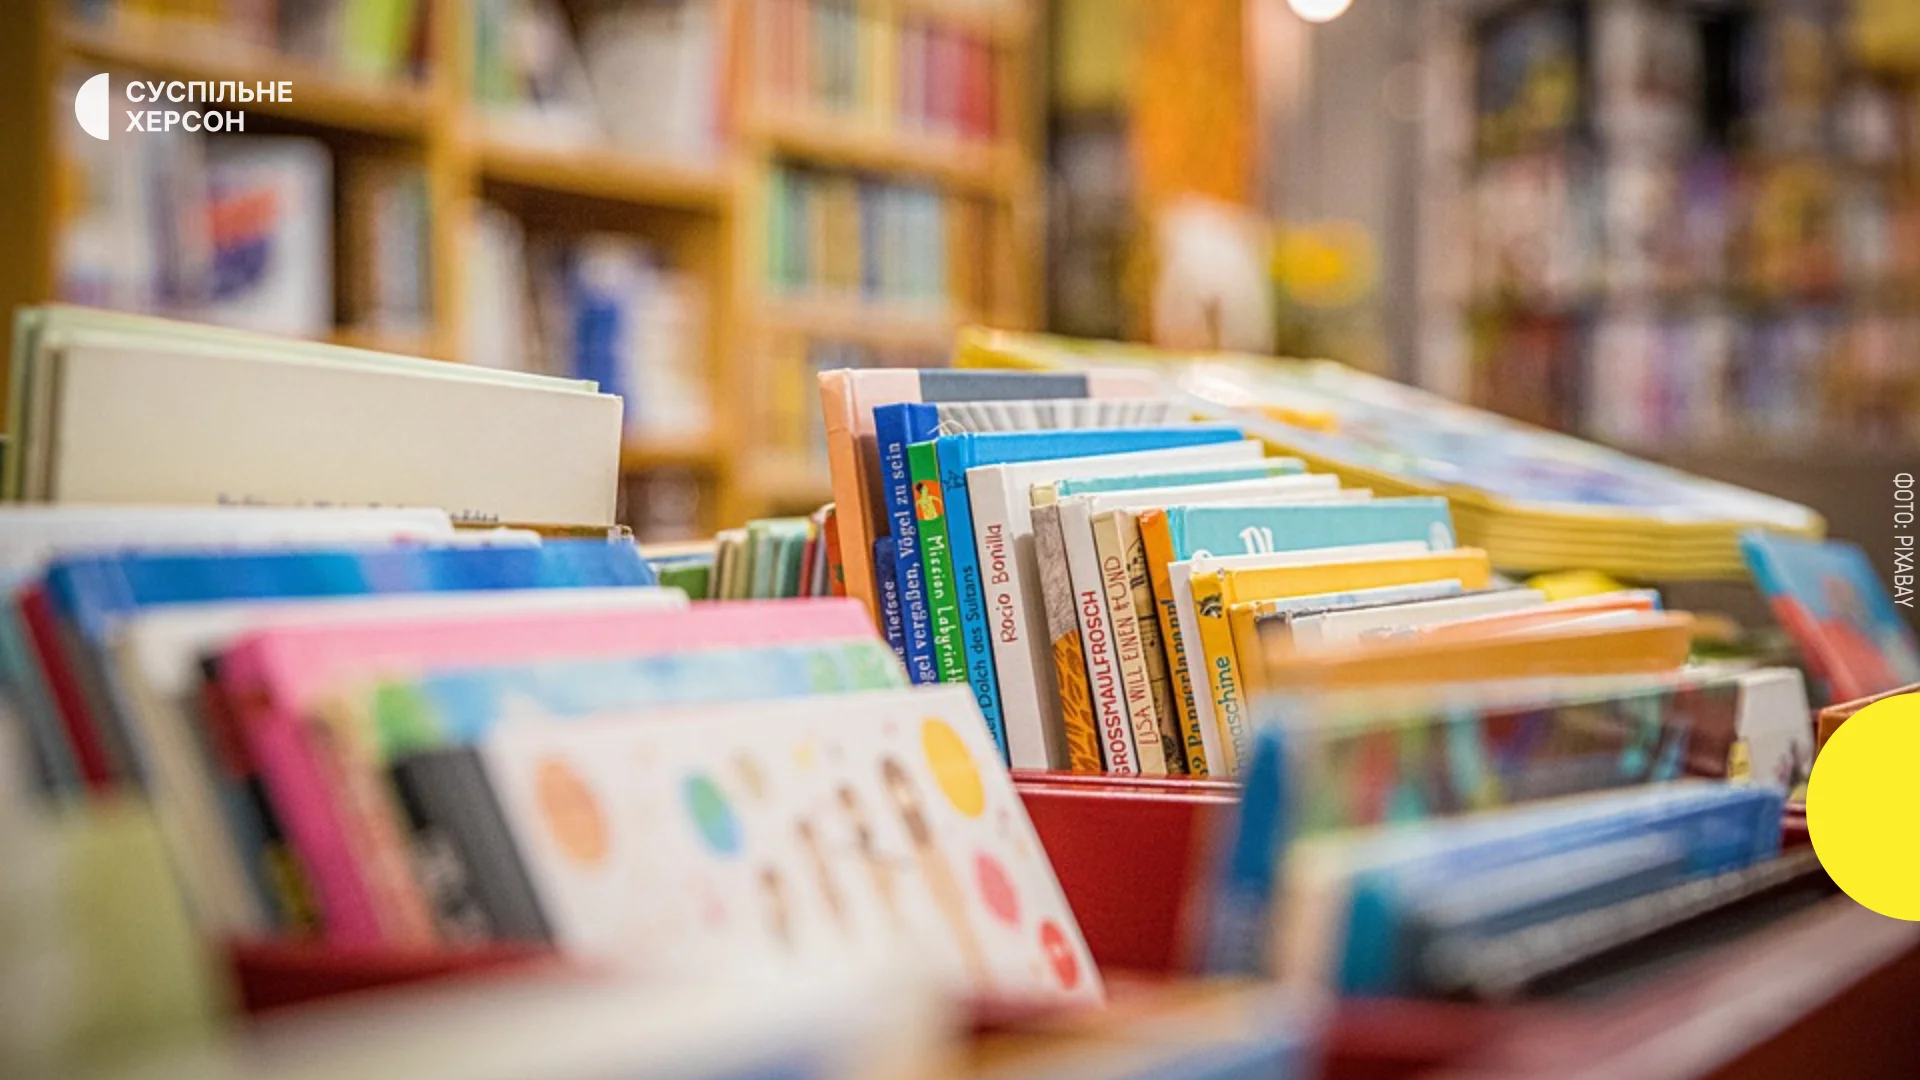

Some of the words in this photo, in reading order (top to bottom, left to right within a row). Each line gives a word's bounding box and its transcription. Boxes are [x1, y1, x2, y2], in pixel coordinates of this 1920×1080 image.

[886, 442, 905, 479] sein
[895, 484, 909, 505] zu
[894, 511, 916, 558] Vögel
[985, 524, 1009, 585] Bonilla
[927, 535, 946, 599] Mission
[1103, 556, 1130, 611] HUND
[884, 581, 901, 640] Tiefsee
[905, 562, 928, 649] vergaßen,
[963, 565, 980, 622] Sultans
[970, 627, 985, 654] des
[1116, 616, 1139, 662] EINEN
[973, 660, 992, 708] Dolch
[1081, 590, 1131, 776] GROSSMAULFROSCH
[1126, 666, 1146, 703] WILL
[1134, 705, 1159, 745] LISA
